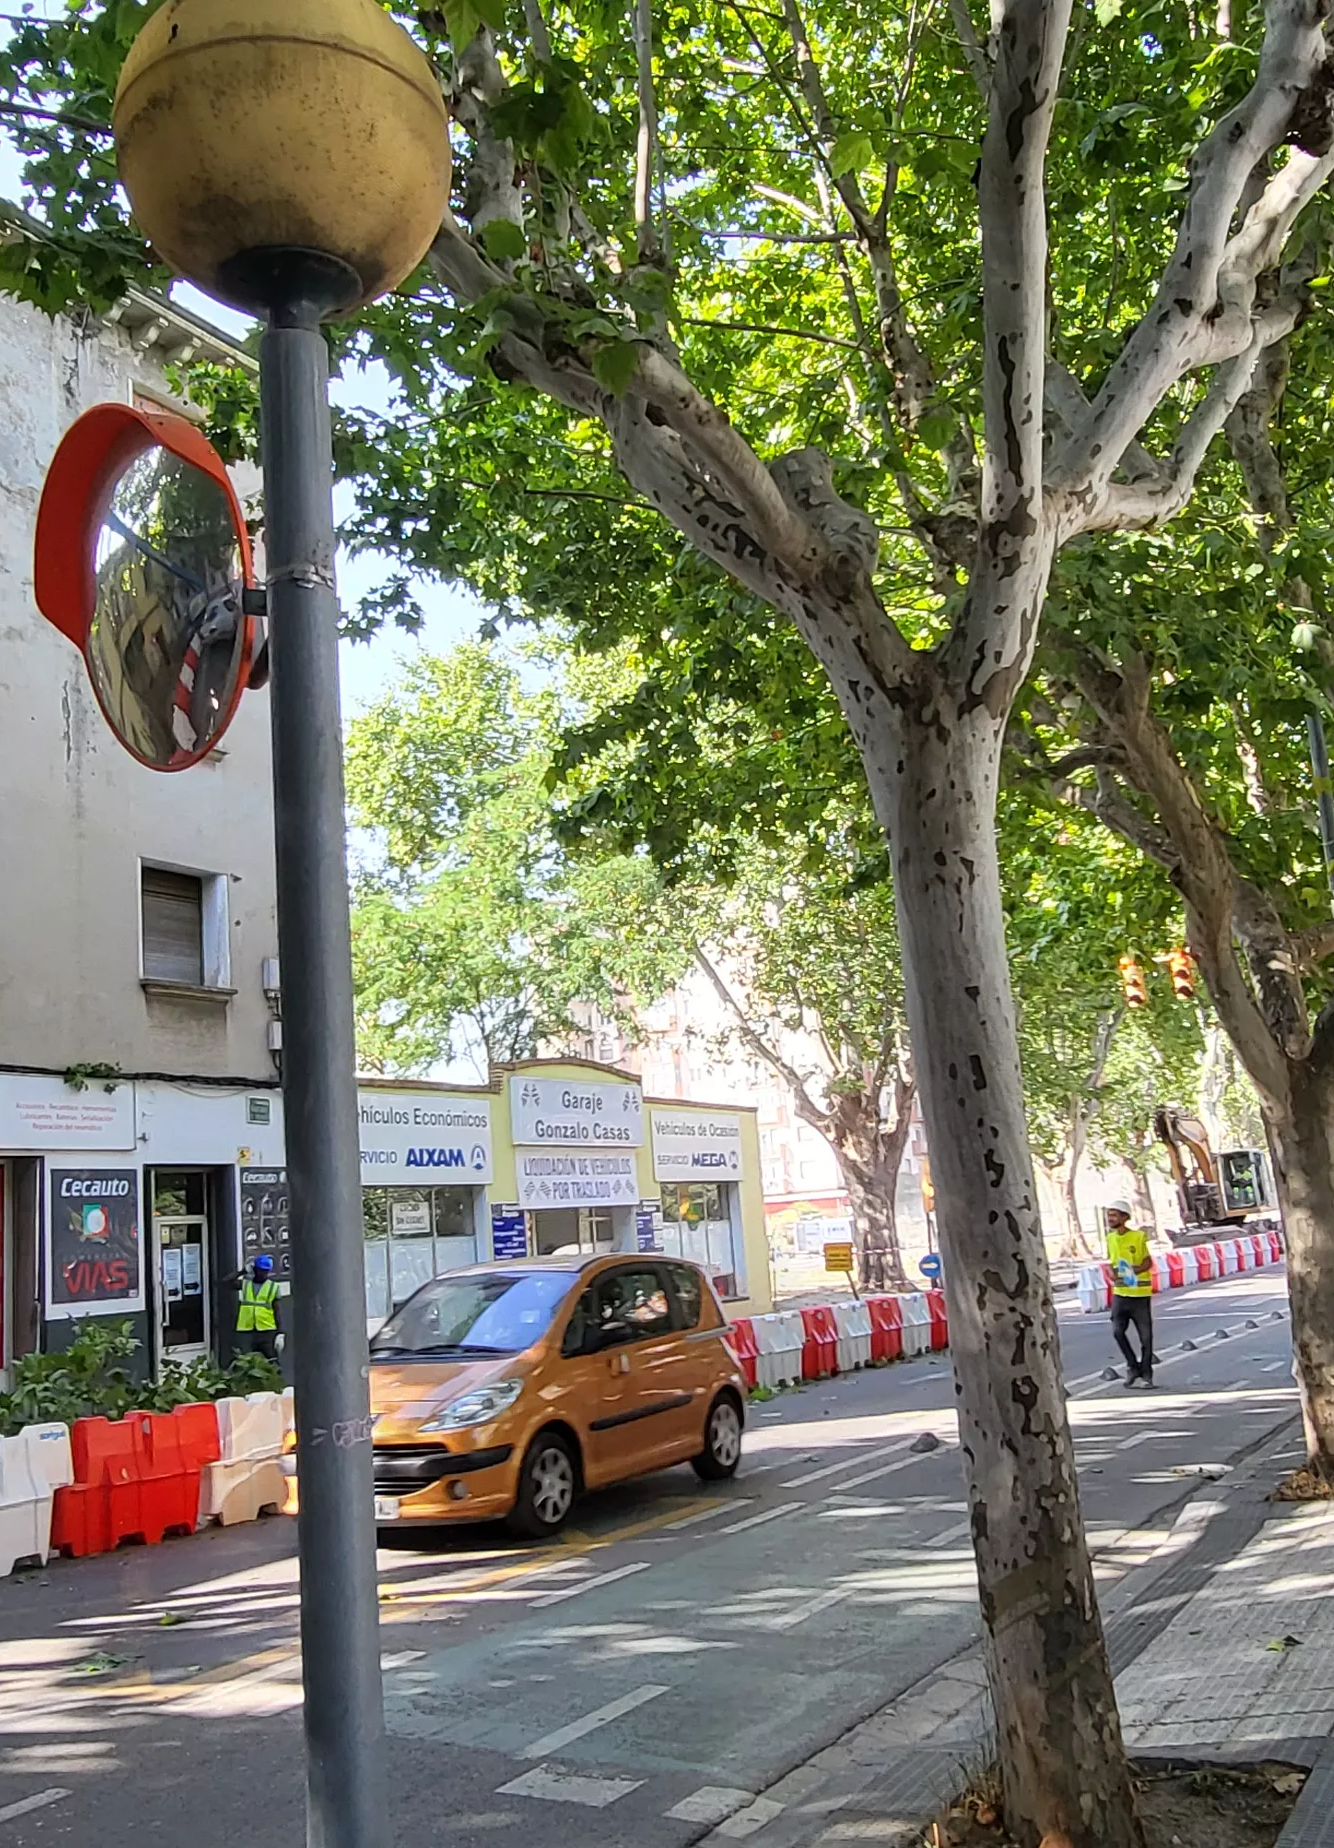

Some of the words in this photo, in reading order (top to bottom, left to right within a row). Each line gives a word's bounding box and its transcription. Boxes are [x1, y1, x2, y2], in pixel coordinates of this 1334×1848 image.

[561, 1090, 603, 1115] Garaje
[358, 1105, 410, 1125] hículos
[413, 1108, 488, 1128] Económicos
[535, 1119, 590, 1140] Gonzalo
[592, 1122, 630, 1140] Casas
[697, 1122, 707, 1137] de
[405, 1148, 466, 1168] AIXAM
[524, 1154, 576, 1177] LIQUIDACIÓN
[577, 1157, 589, 1176] DE
[691, 1152, 727, 1168] MEGA
[60, 1178, 129, 1197] Cecauto
[551, 1181, 569, 1200] POR
[570, 1181, 611, 1199] TRASLADO
[62, 1260, 129, 1294] VIAS
